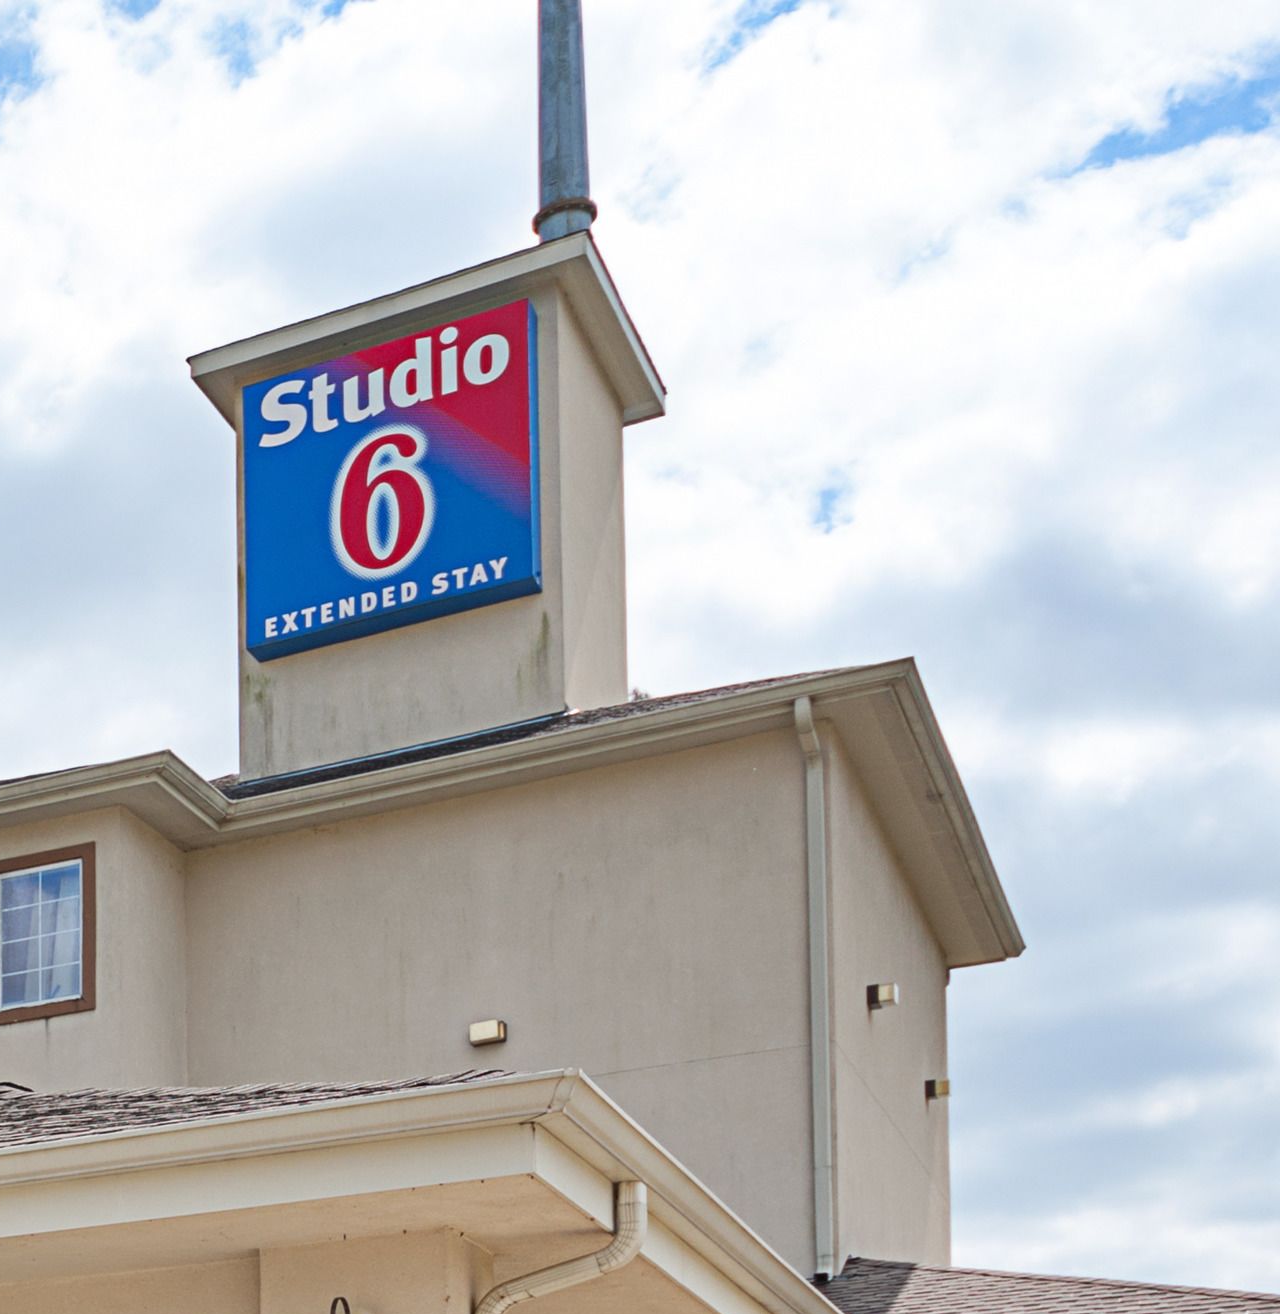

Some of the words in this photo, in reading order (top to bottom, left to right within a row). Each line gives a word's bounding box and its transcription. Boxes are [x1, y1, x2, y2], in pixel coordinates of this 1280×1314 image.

[259, 326, 510, 448] Studio
[336, 428, 429, 575] 6
[265, 582, 418, 639] EXTENDED
[431, 556, 508, 596] STAY
